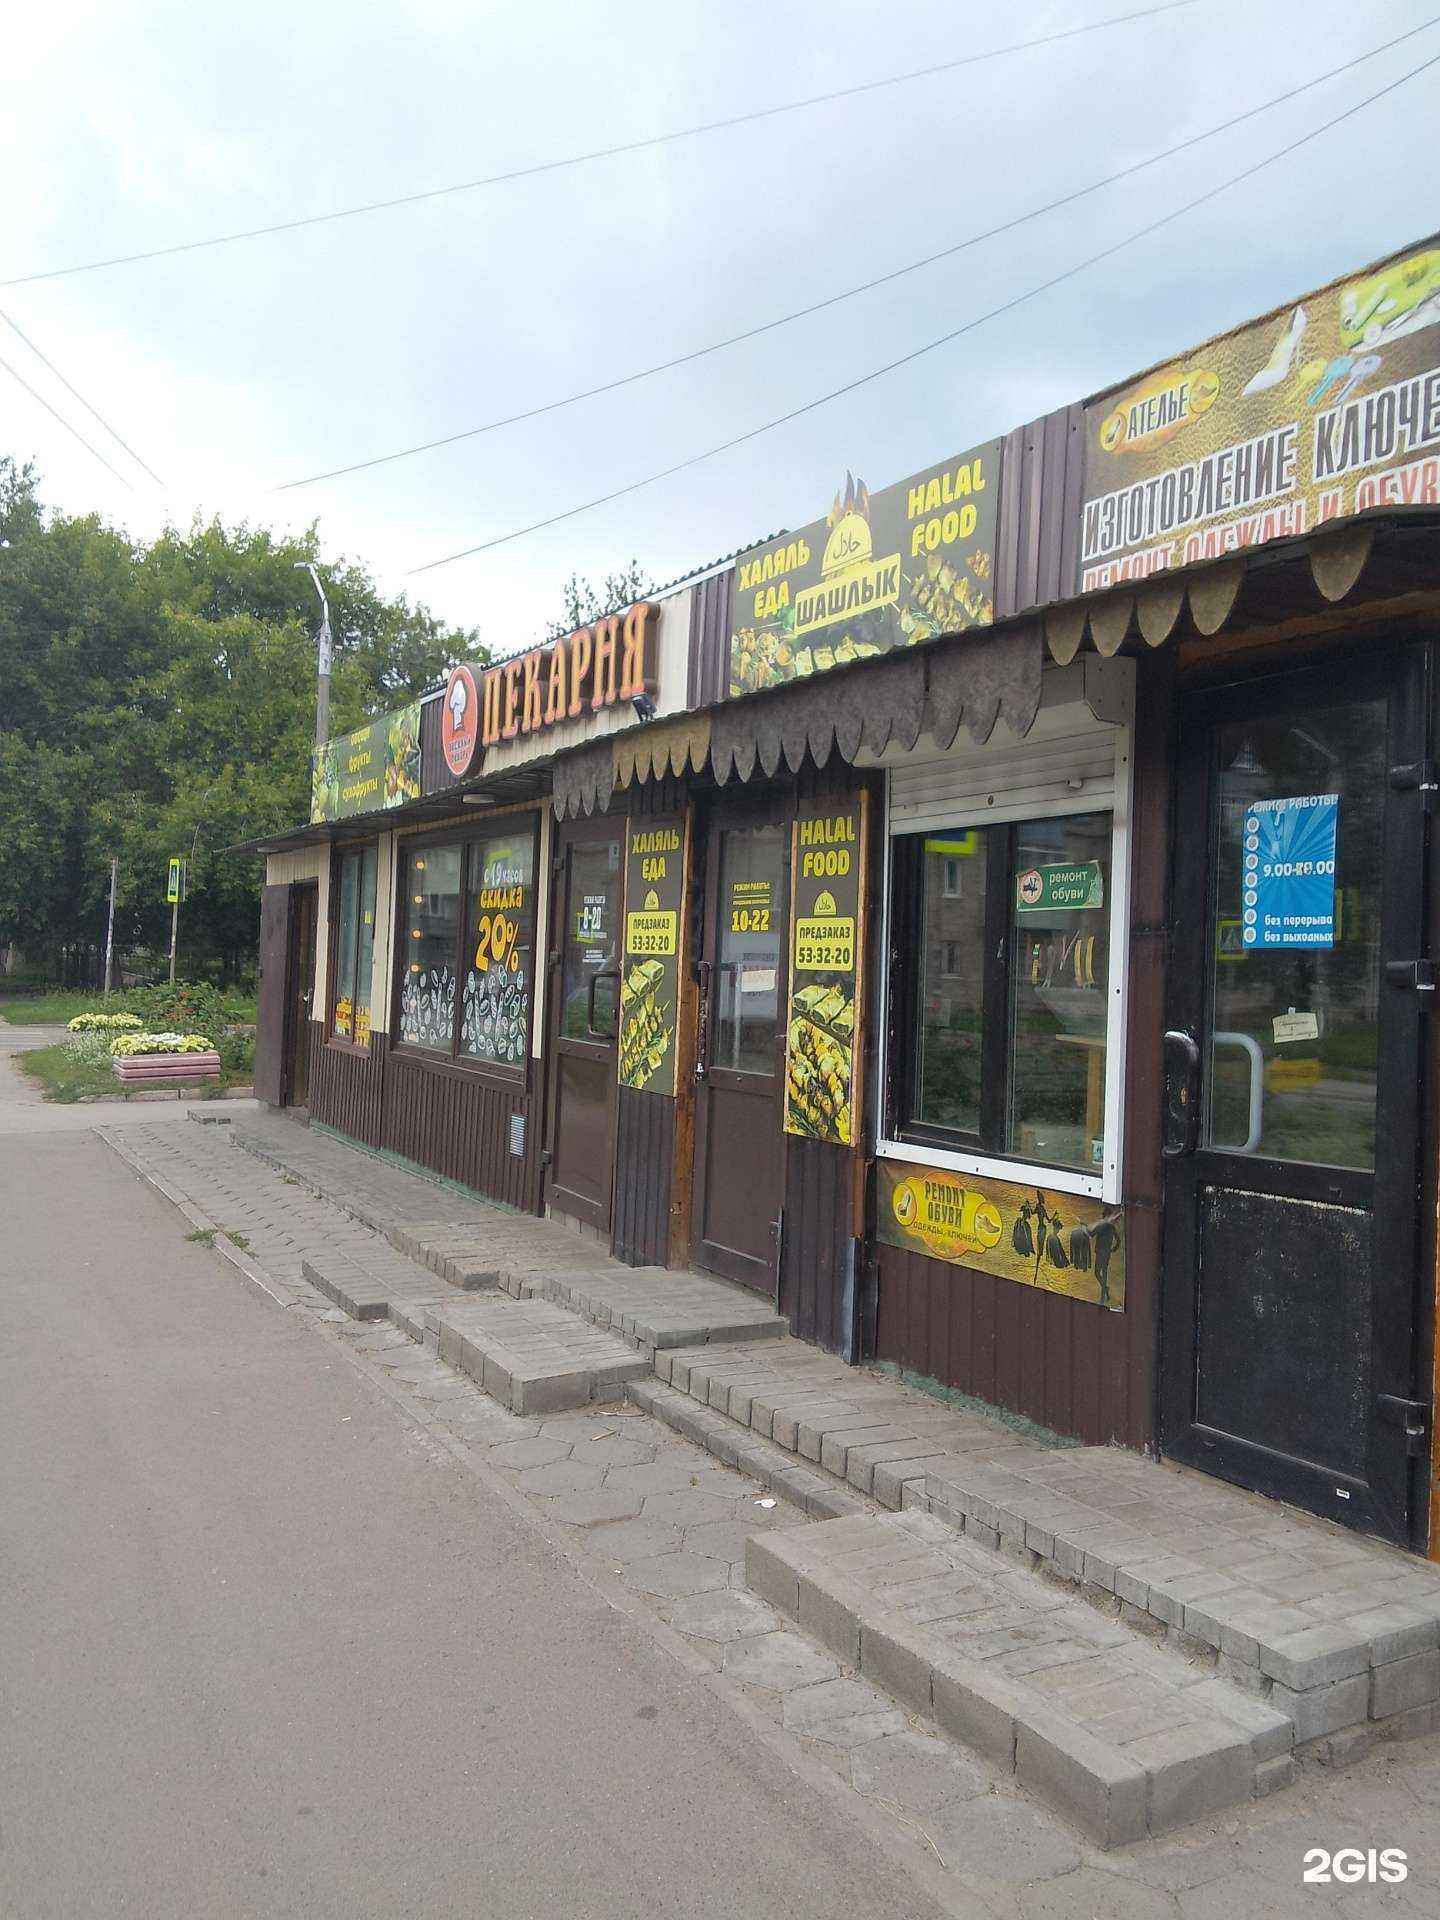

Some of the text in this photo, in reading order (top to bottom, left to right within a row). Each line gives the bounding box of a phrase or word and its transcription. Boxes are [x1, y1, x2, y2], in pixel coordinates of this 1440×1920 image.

[1127, 383, 1189, 439] АТЕЛЬЕ
[1083, 370, 1440, 559] ИЗГОТОВЛЕНИЕ КЛЮЧЕ
[908, 459, 986, 519] HALAL
[912, 504, 977, 556] FOOD
[739, 539, 810, 592] ХАЛЯЛЬ
[754, 581, 789, 618] ЕДА
[798, 564, 898, 625] ШАШЛЫК
[482, 602, 656, 747] ПЕКАРНЯ
[632, 829, 680, 854] ХАЛЯЛЬ
[800, 816, 856, 845] HALAL
[642, 856, 666, 882] ЕДА
[803, 849, 850, 877] FOOD
[1050, 870, 1088, 884] ремонт
[1051, 889, 1084, 903] обуви
[583, 906, 602, 930] 8-20
[633, 918, 670, 933] ПРЕДЗАКАЗ
[732, 909, 769, 931] 10-22
[1264, 914, 1333, 927] без перерыва
[475, 913, 519, 972] 20%
[632, 935, 669, 951] 53-32-20
[799, 926, 850, 940] ПРЕДЗАКАЗ
[1264, 930, 1334, 943] без выходных
[798, 947, 850, 964] 53-32-20
[925, 1180, 966, 1208] РЕМОНТ
[927, 1202, 962, 1227] ОБУВИ
